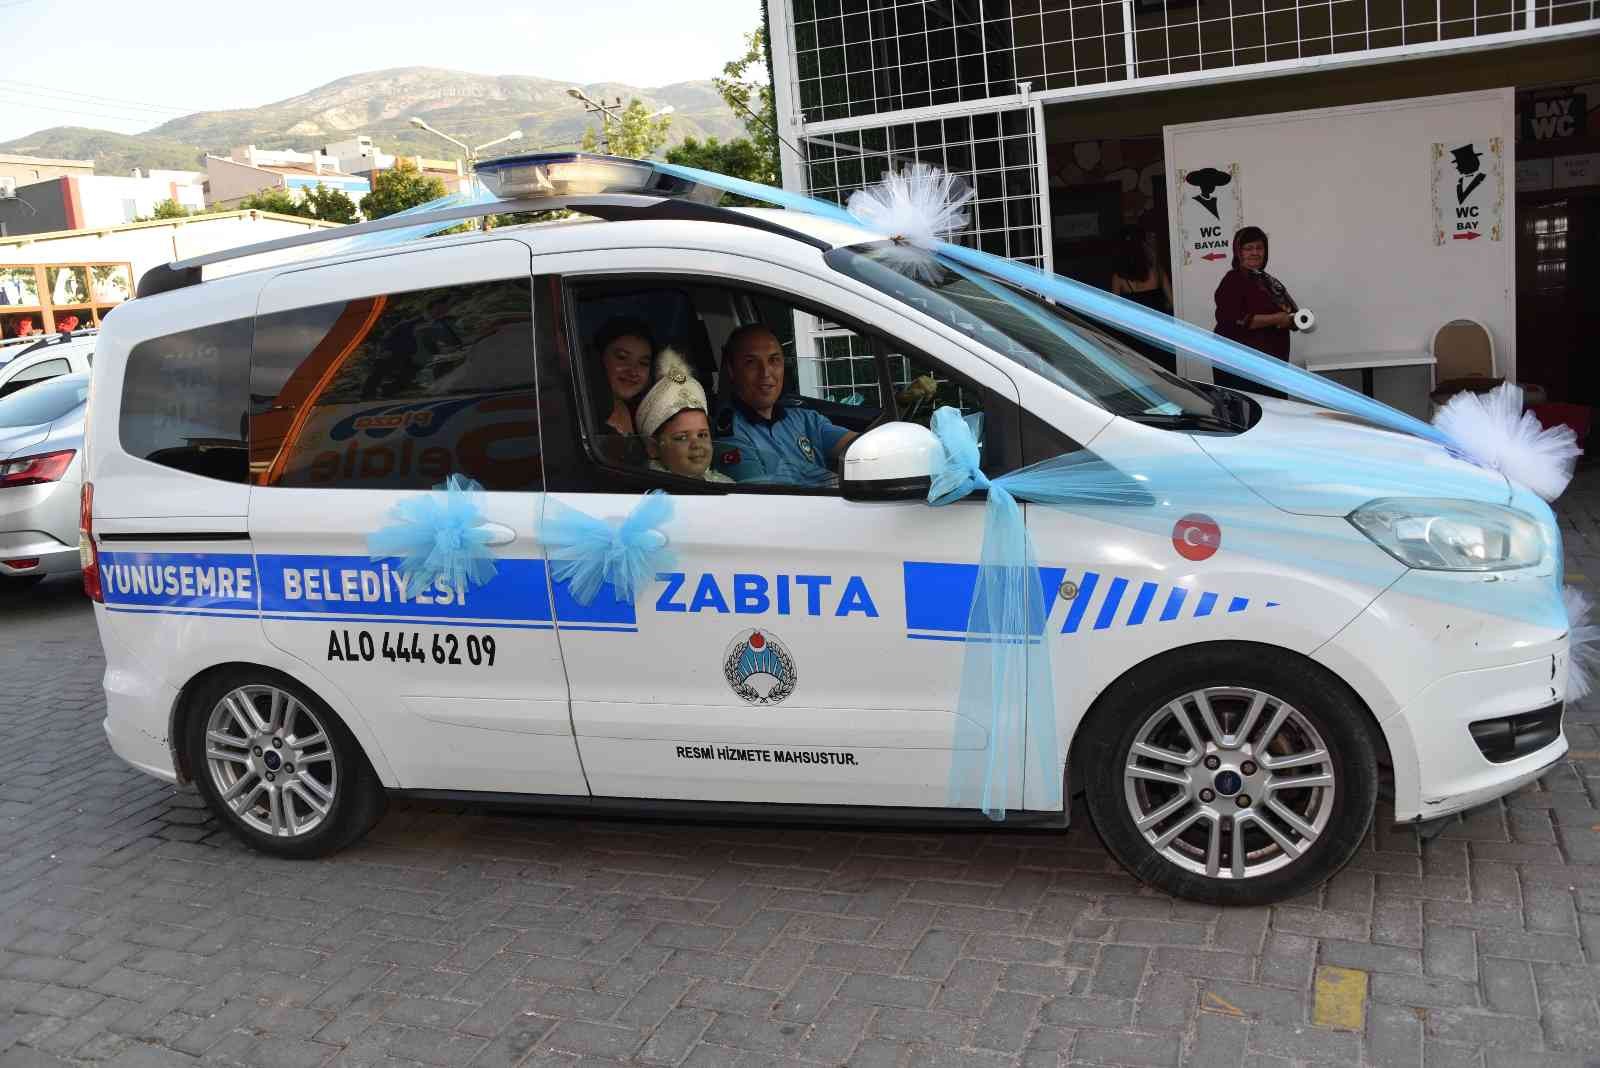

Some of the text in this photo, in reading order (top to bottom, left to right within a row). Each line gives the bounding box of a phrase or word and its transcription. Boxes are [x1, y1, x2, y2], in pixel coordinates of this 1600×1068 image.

[1528, 117, 1575, 138] WC
[1456, 206, 1479, 218] WC
[1200, 226, 1221, 238] WC
[1457, 221, 1479, 230] BAY
[1195, 240, 1229, 249] BAYAN
[101, 564, 252, 599] YUNUSEMRE
[655, 572, 879, 617] ZABITA
[328, 630, 496, 666] ALO 444 62 09
[676, 745, 859, 766] RESMİ HİZMETE MAHSUSTUR.
